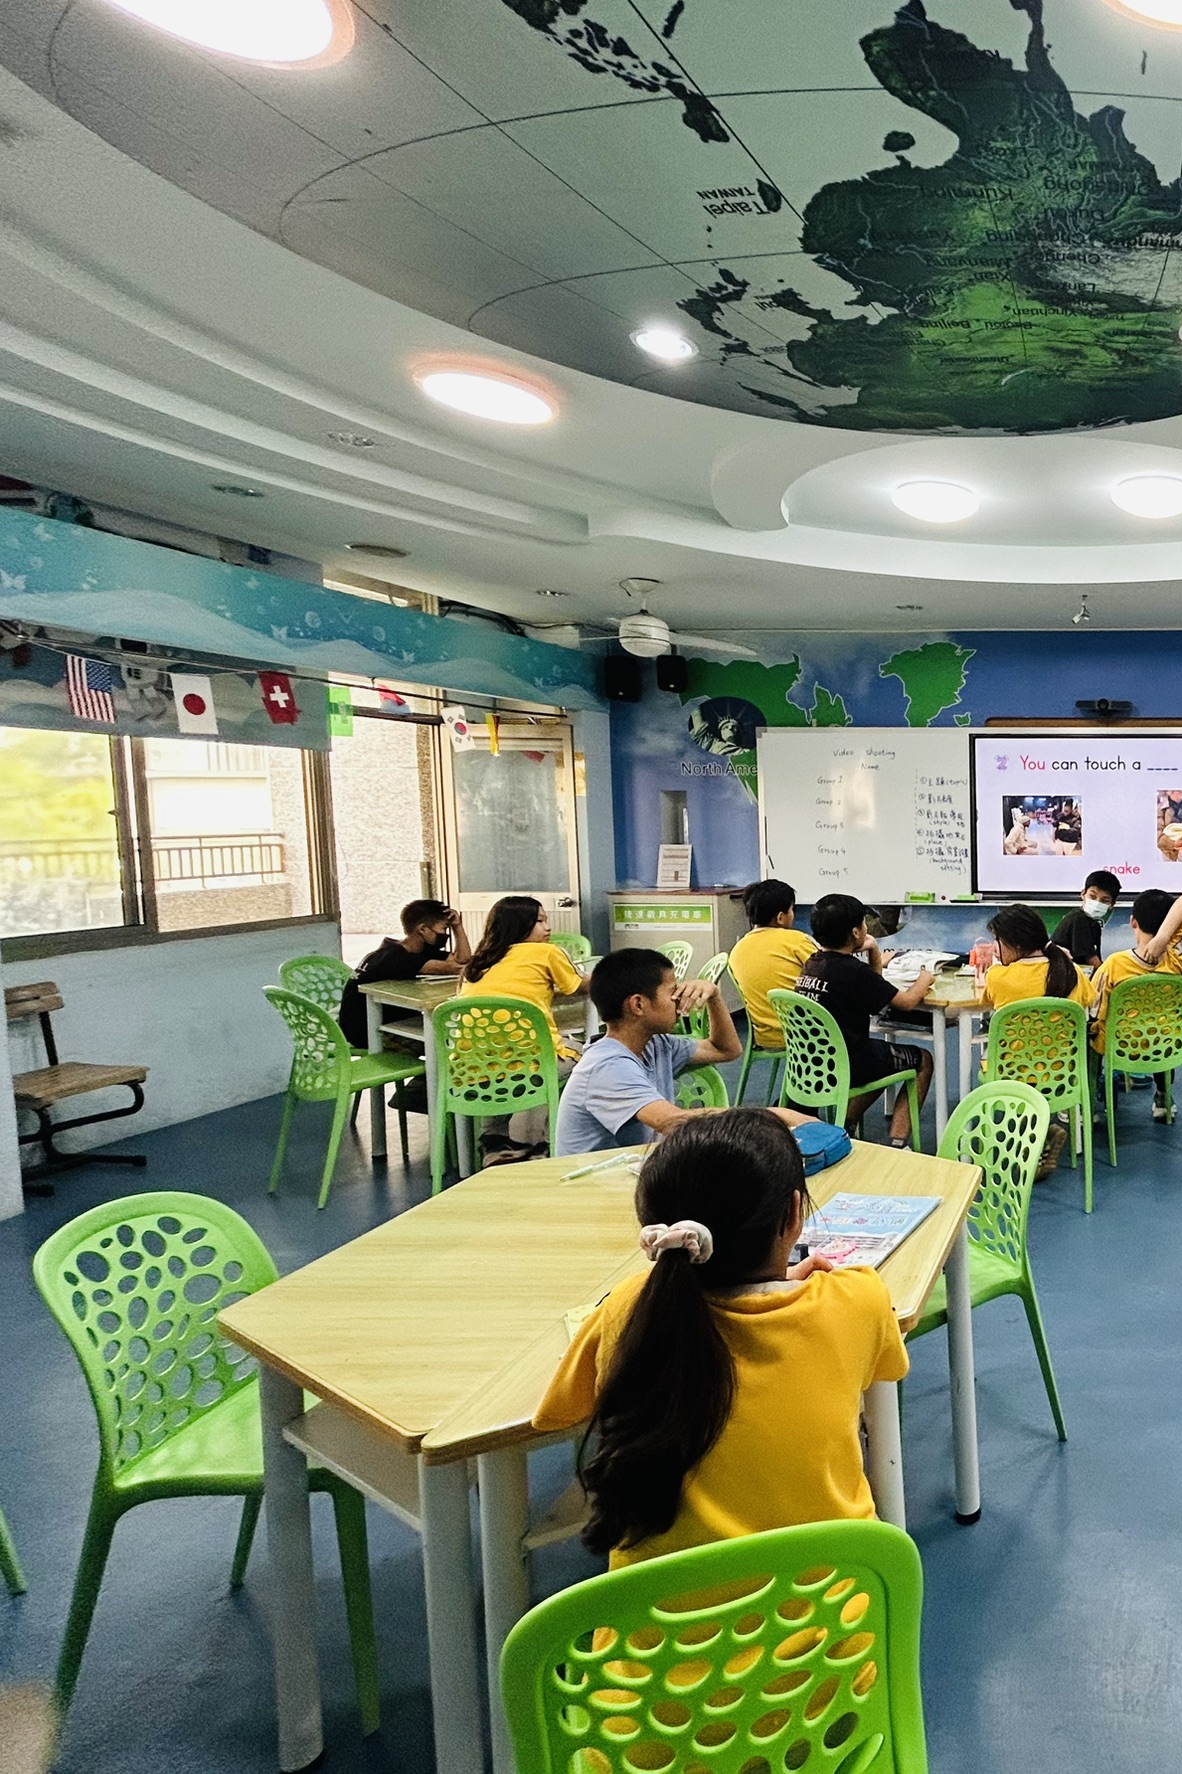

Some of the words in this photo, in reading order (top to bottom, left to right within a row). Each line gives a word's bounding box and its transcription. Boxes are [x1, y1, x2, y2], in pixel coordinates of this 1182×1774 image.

[695, 186, 756, 200] TAIWAN
[702, 200, 770, 219] Taipei
[681, 761, 722, 776] North
[1020, 755, 1046, 770] You
[1051, 758, 1078, 770] can
[1084, 755, 1126, 770] touch
[1132, 758, 1141, 770] a
[1103, 862, 1141, 875] snake
